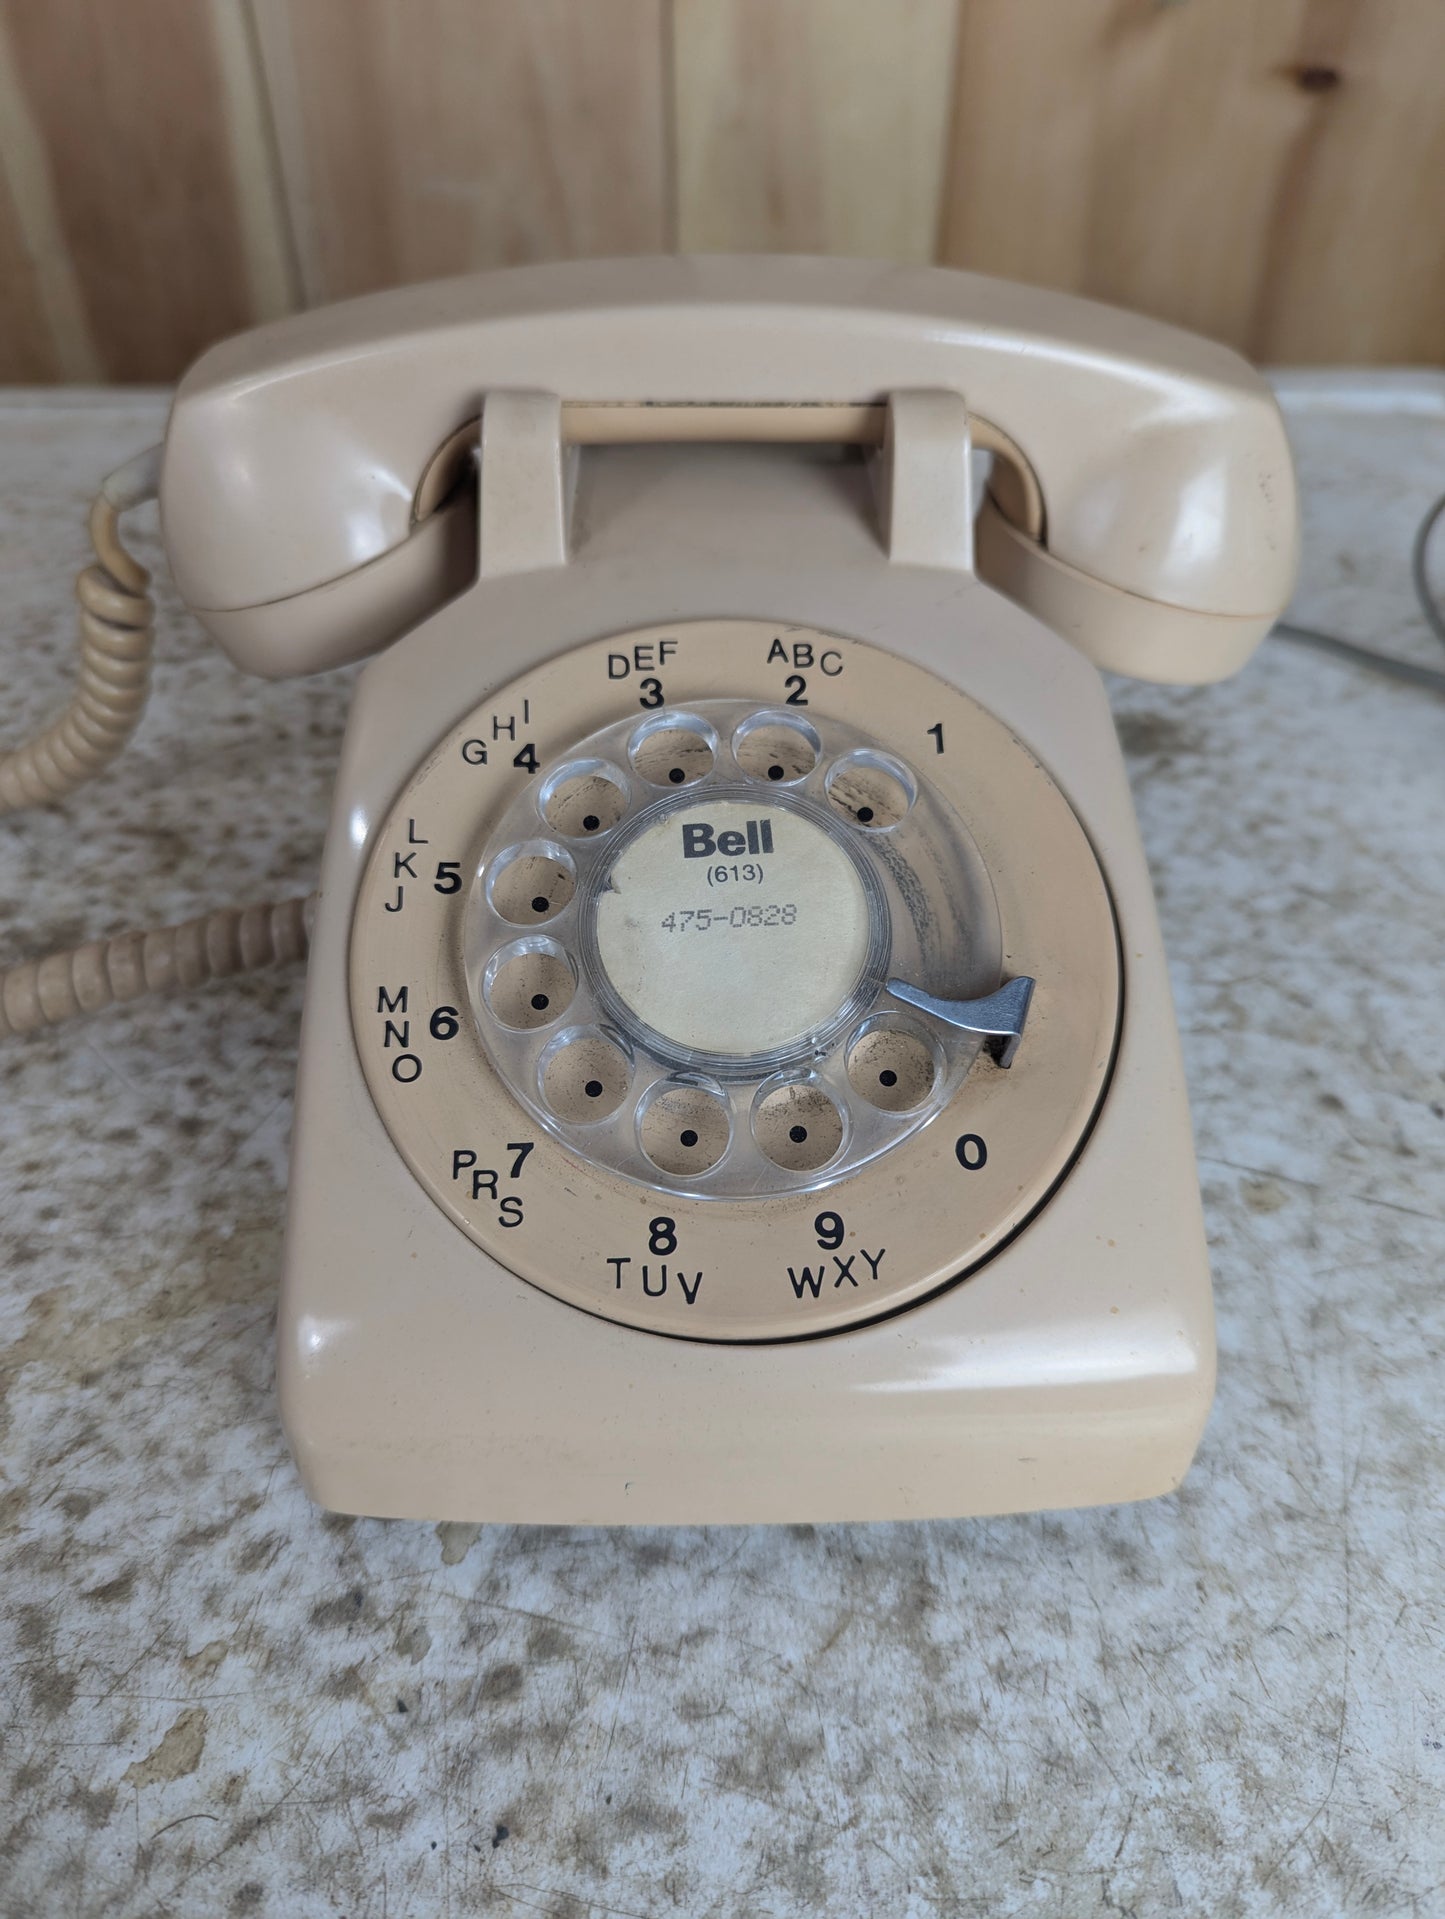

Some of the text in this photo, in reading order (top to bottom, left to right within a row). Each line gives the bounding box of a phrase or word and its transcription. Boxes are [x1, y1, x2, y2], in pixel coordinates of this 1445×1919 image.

[608, 640, 678, 680] DEF
[767, 638, 844, 676] ABC
[640, 678, 665, 709] 3
[785, 675, 809, 706] 2
[927, 723, 945, 754] 1
[513, 743, 540, 774] 4
[682, 819, 774, 858] Bell
[434, 862, 462, 894] 5
[707, 864, 764, 887] (613)
[661, 904, 797, 932] 475-0828
[429, 1006, 460, 1040] 6
[507, 1142, 534, 1178] 7
[955, 1134, 987, 1170] 0
[648, 1217, 677, 1255] 8
[814, 1211, 845, 1250] 9
[607, 1257, 703, 1305] TUV
[787, 1249, 885, 1298] WXY
